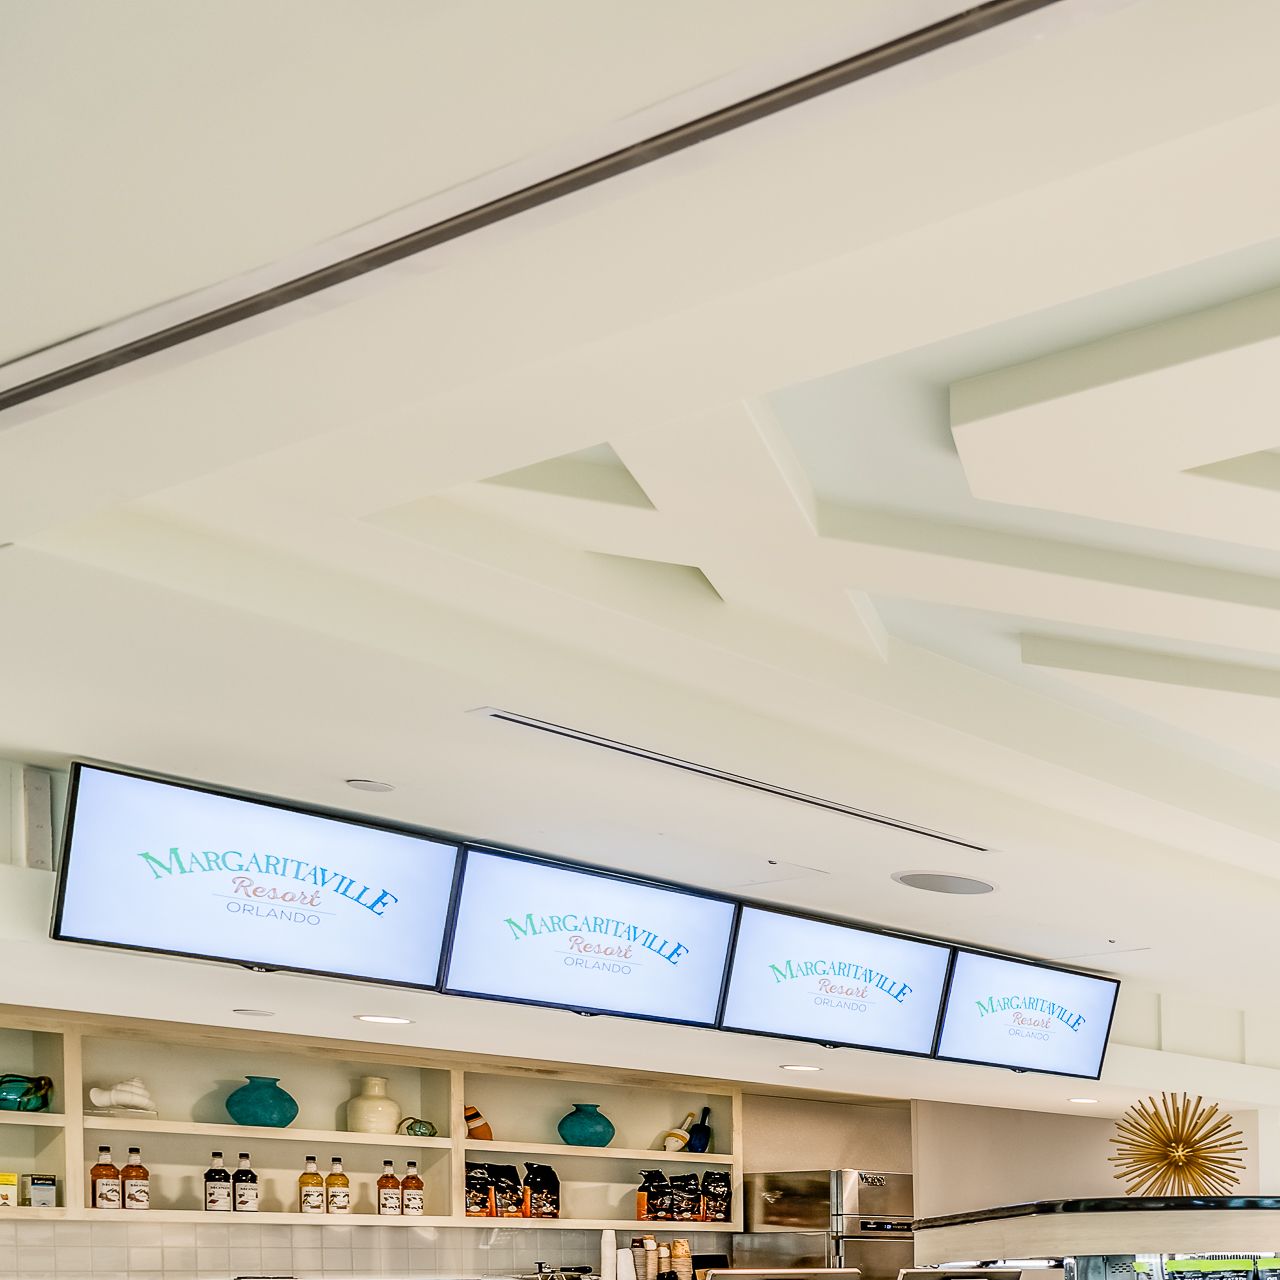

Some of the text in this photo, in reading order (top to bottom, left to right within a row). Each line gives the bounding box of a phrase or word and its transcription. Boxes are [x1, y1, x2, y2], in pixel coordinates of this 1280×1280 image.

[137, 847, 399, 917] MARGARITAVILLE
[231, 876, 322, 907] Resort
[226, 901, 321, 926] ORLANDO
[503, 913, 690, 965] MARGARITAVILLE
[568, 935, 633, 959] Resort
[563, 956, 632, 975] ORLANDO
[768, 959, 913, 1003] MARGARITAVILLE
[975, 995, 1086, 1032] MARGARITAVILLE
